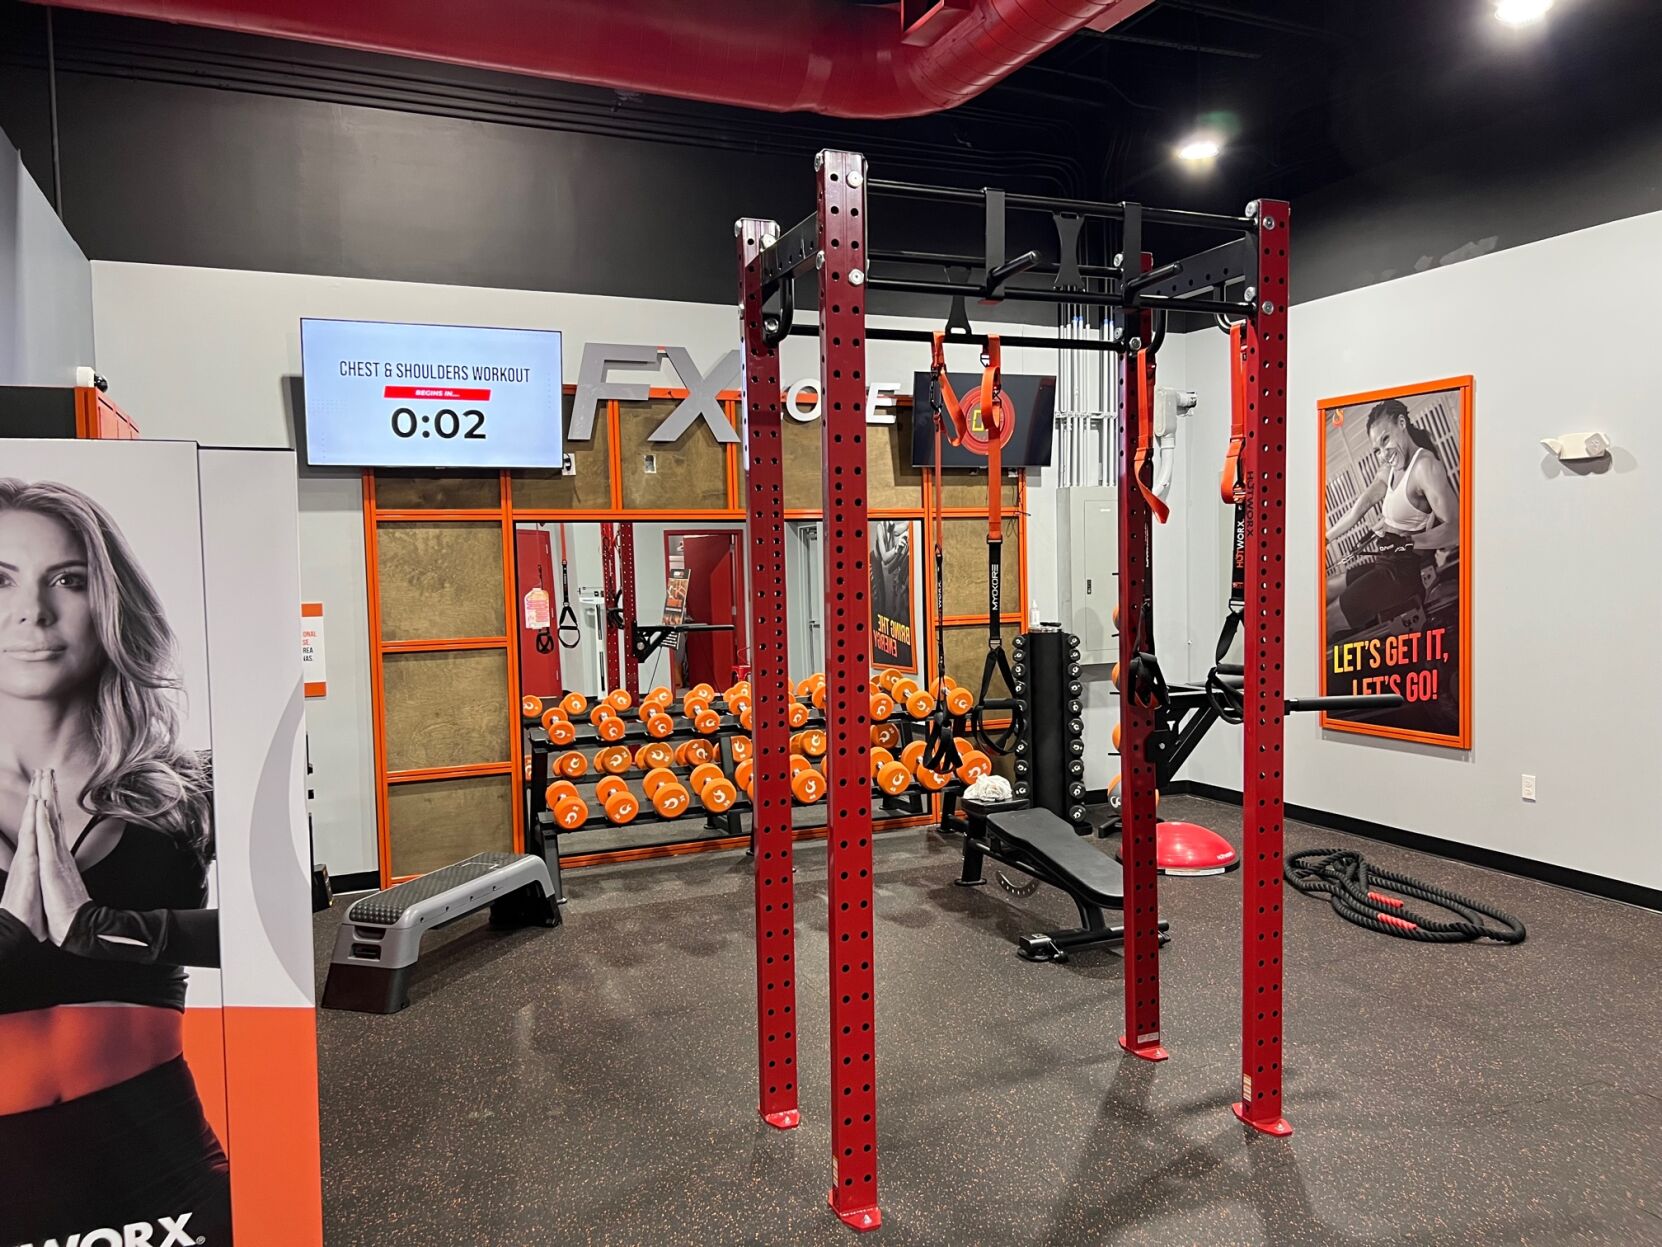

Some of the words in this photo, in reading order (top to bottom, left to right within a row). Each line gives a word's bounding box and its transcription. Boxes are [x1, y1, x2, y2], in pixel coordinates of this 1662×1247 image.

[339, 360, 380, 377] CHEST
[384, 363, 393, 378] &
[396, 363, 469, 381] SHOULDERS
[472, 366, 531, 383] WORKOUT
[415, 389, 443, 397] BEGINS
[567, 342, 741, 442] FX
[391, 408, 487, 440] 0:02
[1333, 638, 1381, 674] LET'S
[1385, 631, 1421, 666] GET
[1426, 627, 1449, 663] IT,
[1406, 669, 1438, 703] GO!
